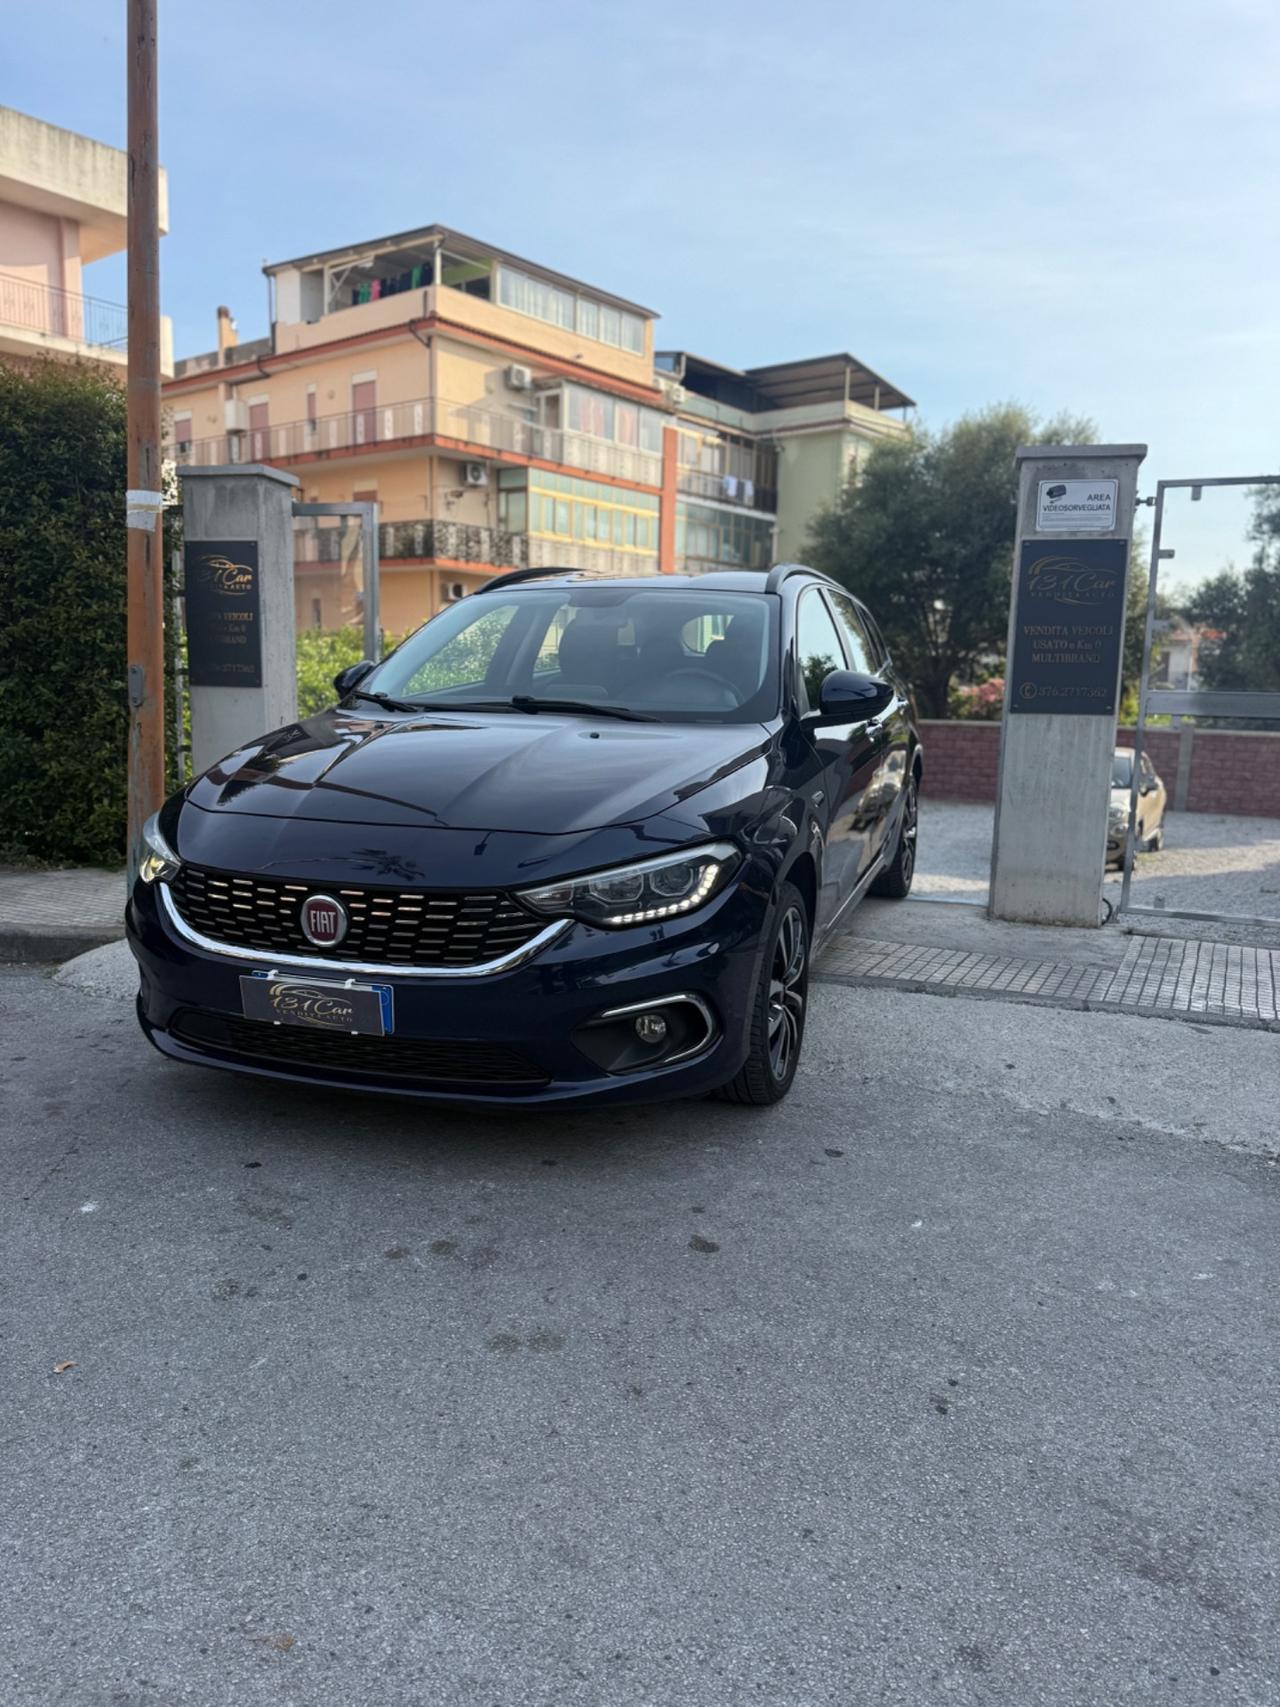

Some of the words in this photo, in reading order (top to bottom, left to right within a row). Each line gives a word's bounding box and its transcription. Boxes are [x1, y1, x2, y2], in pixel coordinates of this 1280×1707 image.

[1087, 493, 1111, 501] AREA
[1043, 503, 1111, 512] VIDEOSORVEGLIATA
[1074, 571, 1116, 592] Car
[1024, 625, 1068, 636] VENDITA
[1071, 625, 1113, 636] VEICOLI
[1033, 639, 1068, 650] USATO
[1032, 653, 1100, 664] MULTIBRAND
[310, 910, 336, 934] FIAT
[272, 996, 312, 1011] 131
[314, 999, 353, 1015] Car
